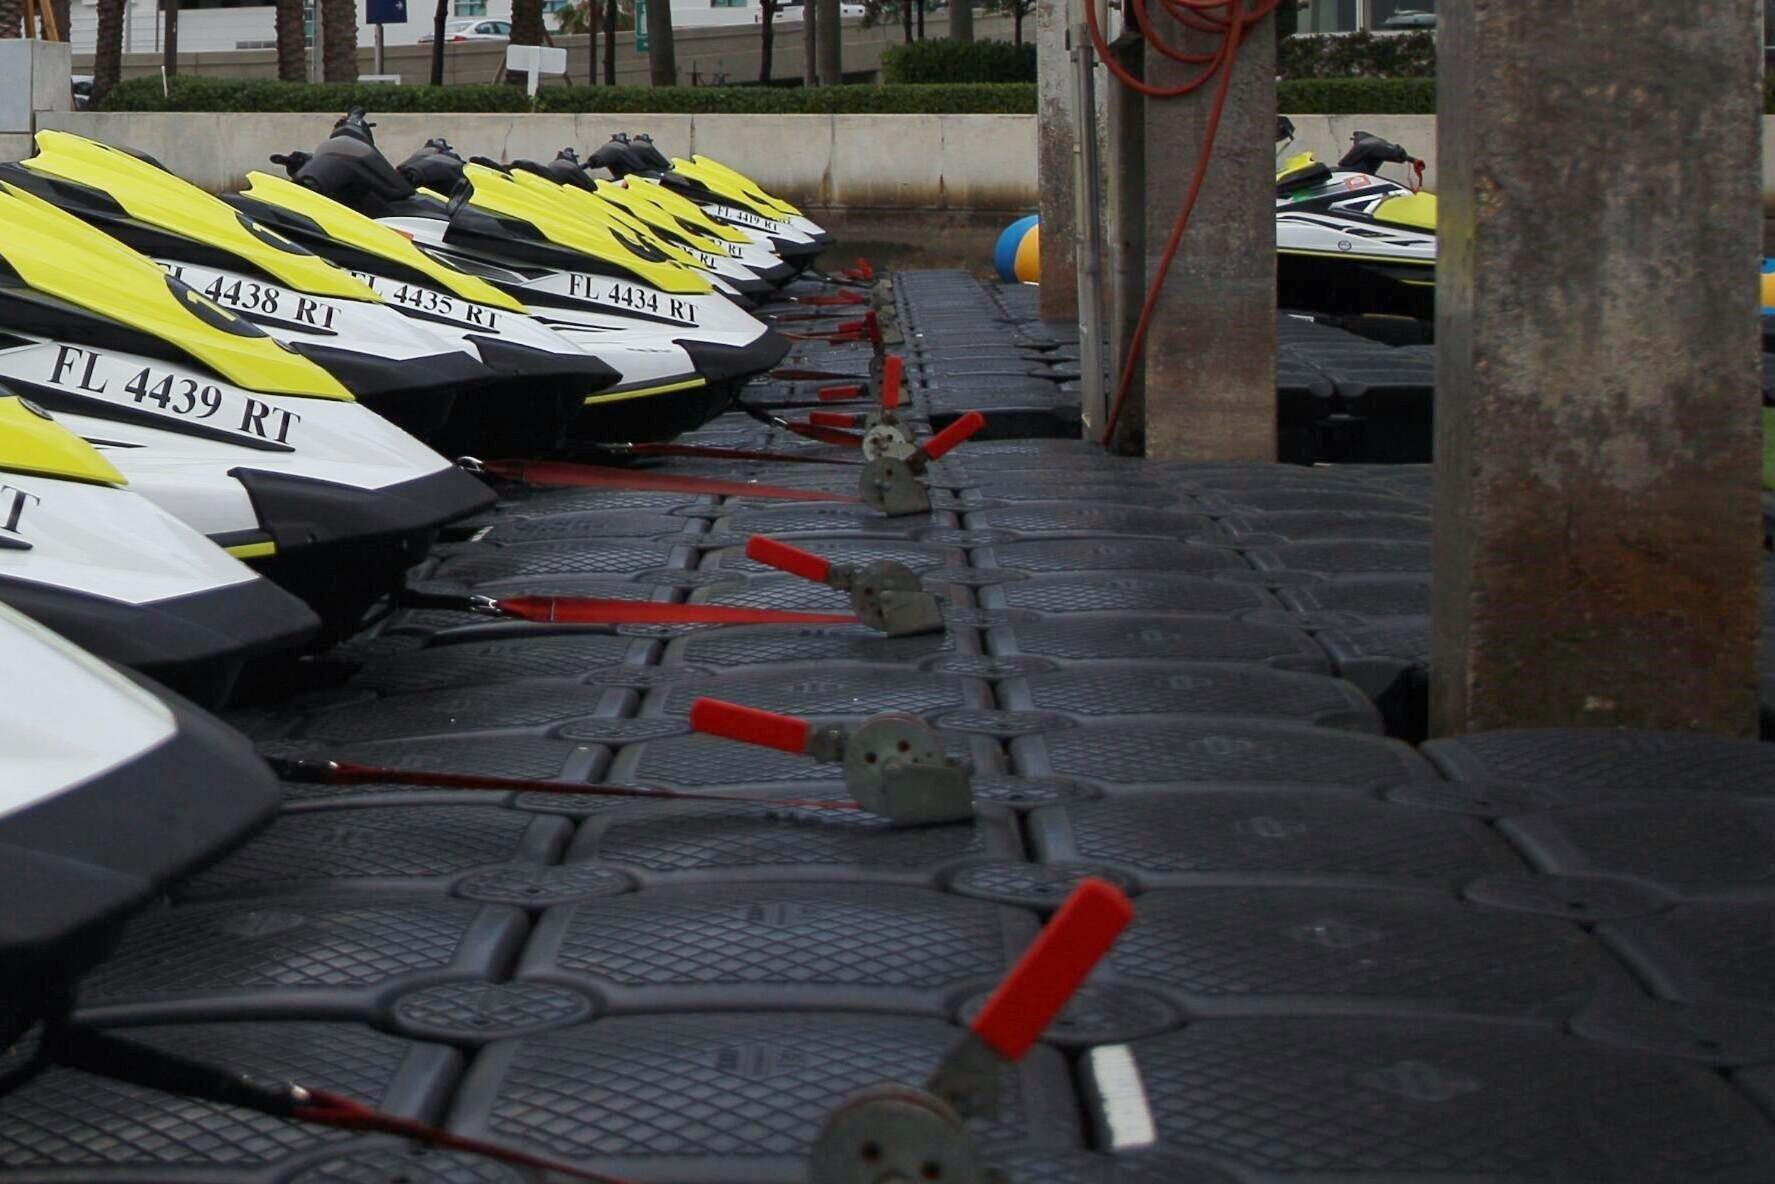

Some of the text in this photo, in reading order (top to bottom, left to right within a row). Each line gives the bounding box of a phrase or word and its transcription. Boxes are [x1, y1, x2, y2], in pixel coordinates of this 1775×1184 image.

[204, 275, 280, 314] 4438
[294, 297, 342, 329] RT
[393, 284, 453, 314] 4435
[466, 304, 503, 329] RT
[568, 273, 699, 323] FL 4434 RT
[47, 343, 302, 445] FL 4439 RT
